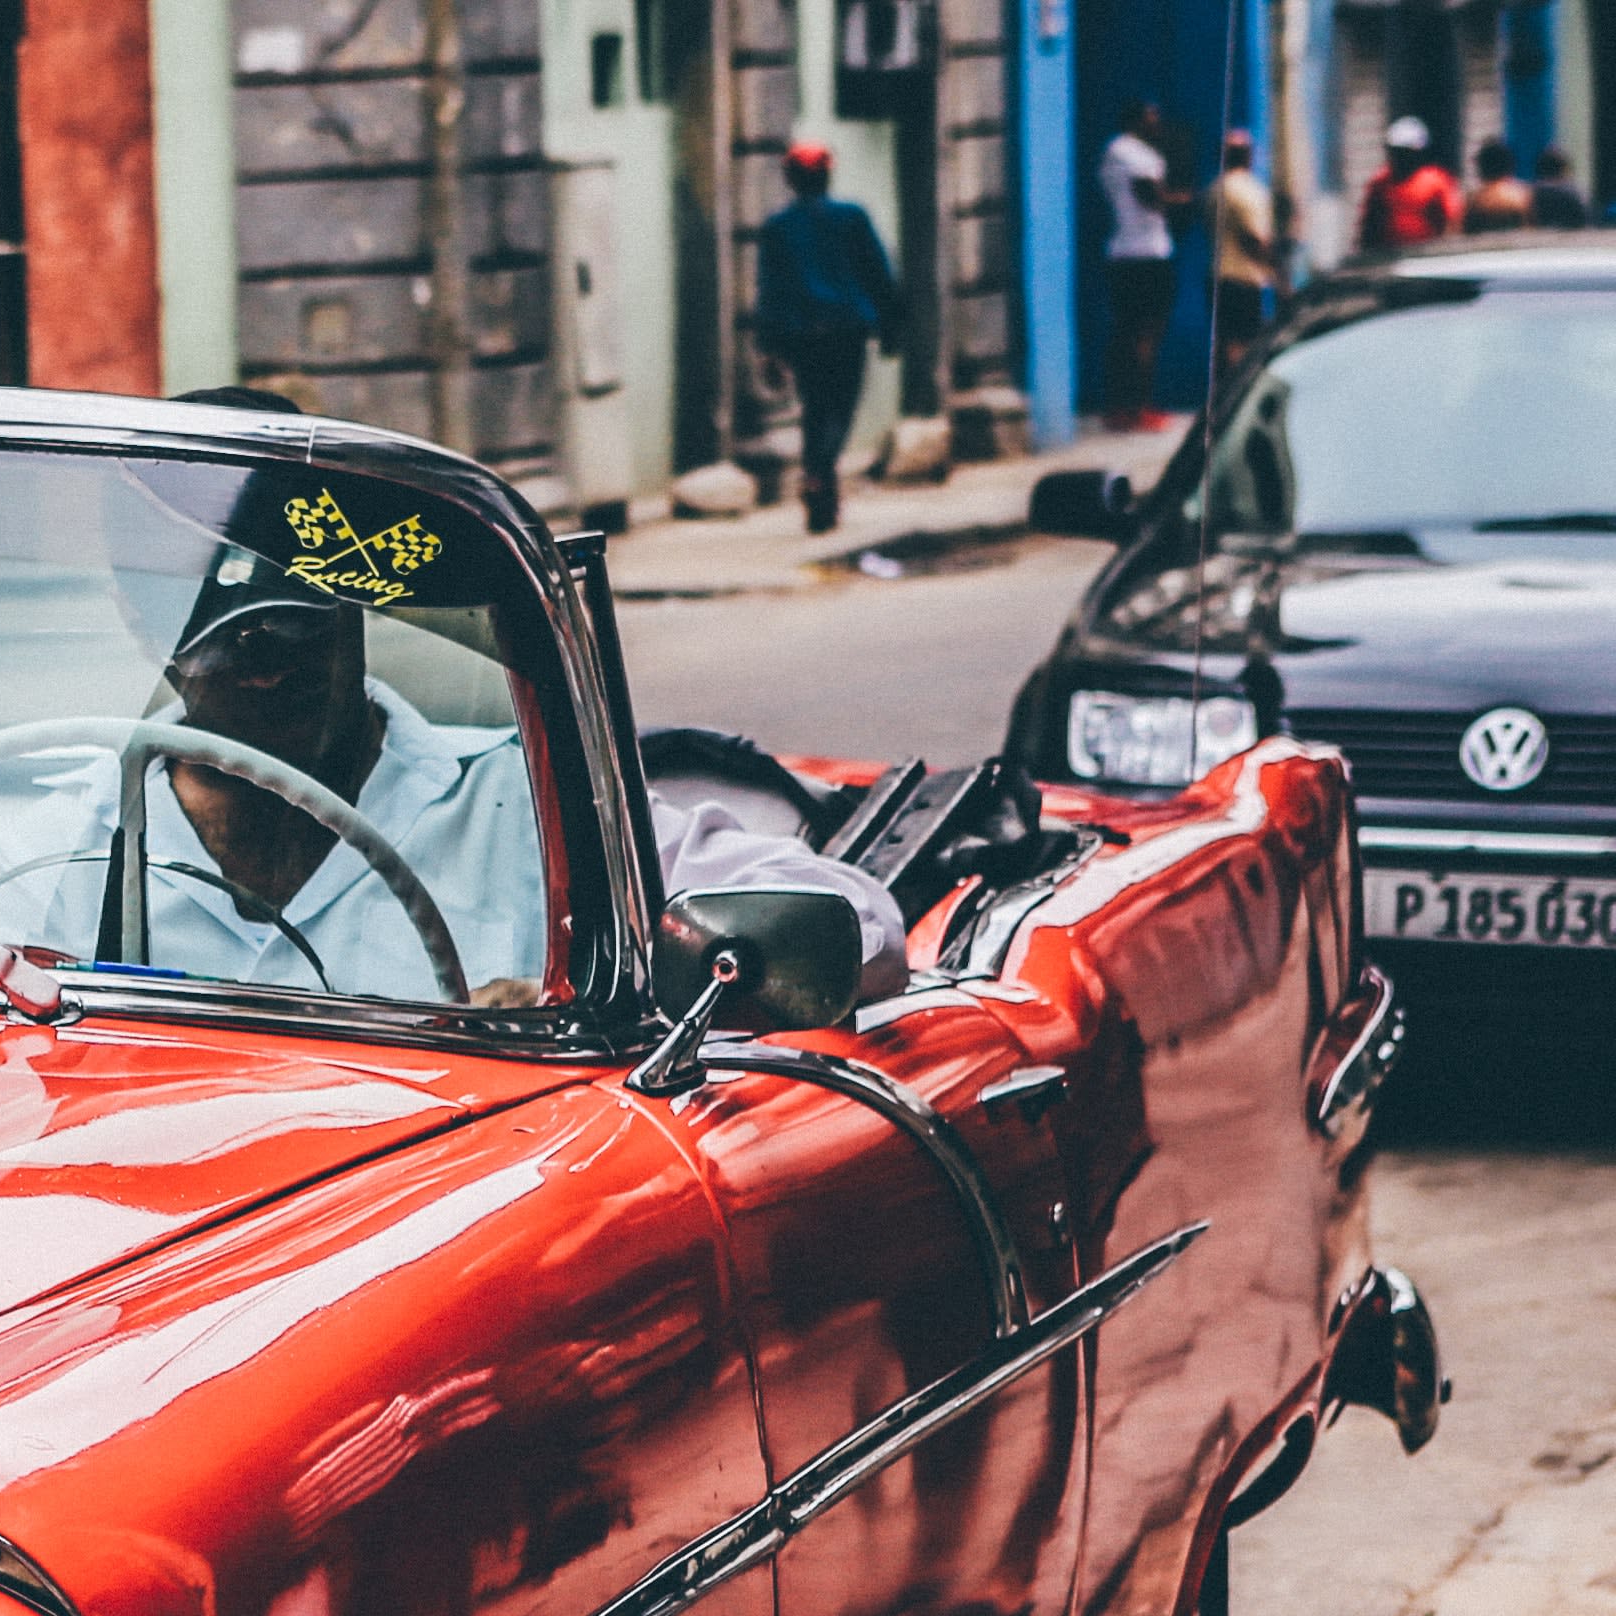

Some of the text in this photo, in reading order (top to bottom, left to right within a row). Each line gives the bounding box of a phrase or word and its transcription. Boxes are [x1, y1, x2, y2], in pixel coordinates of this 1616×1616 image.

[285, 555, 414, 606] Racing
[1396, 884, 1425, 934] P
[1434, 886, 1526, 940] 185
